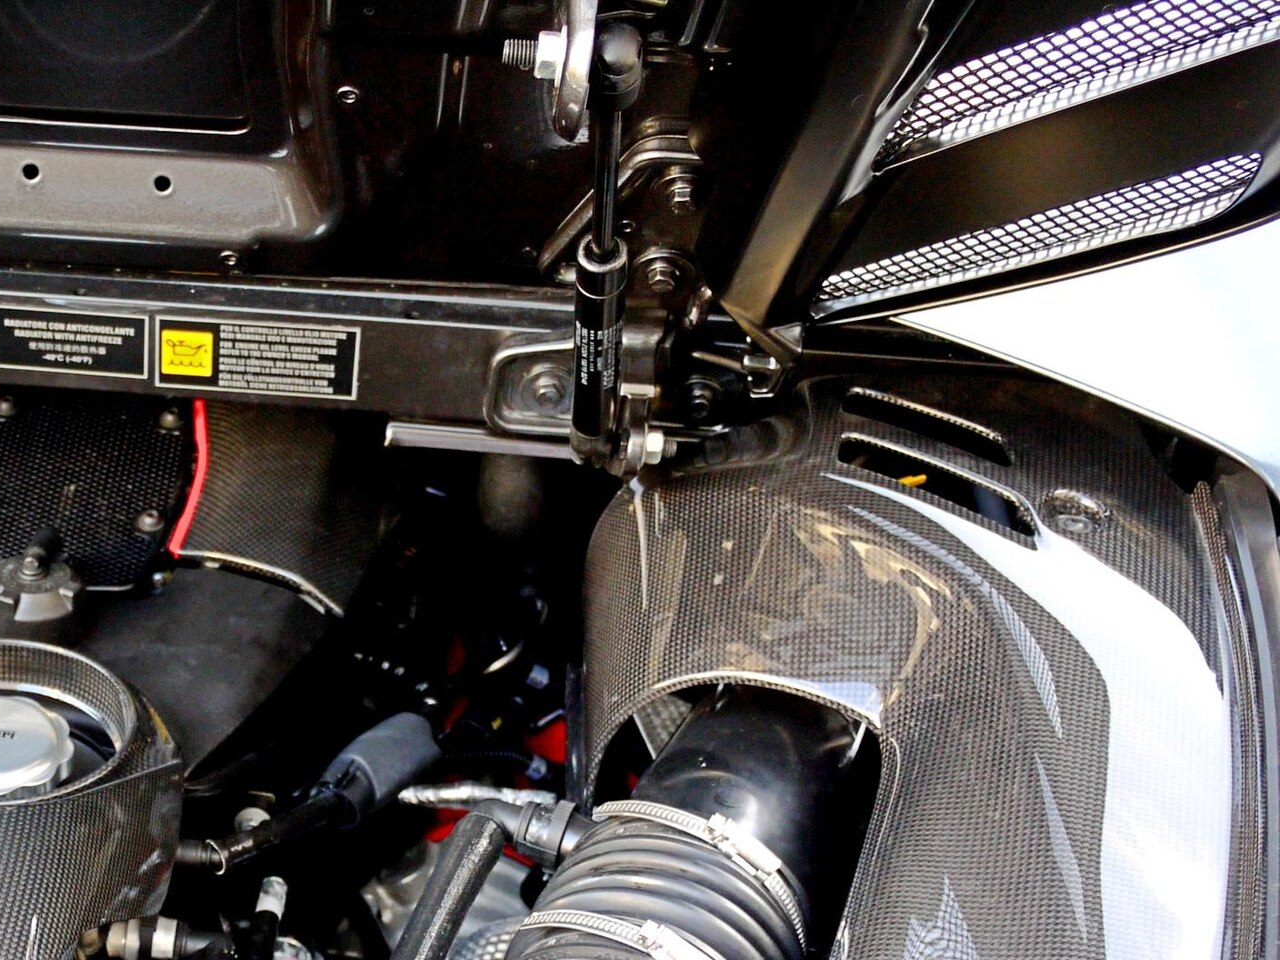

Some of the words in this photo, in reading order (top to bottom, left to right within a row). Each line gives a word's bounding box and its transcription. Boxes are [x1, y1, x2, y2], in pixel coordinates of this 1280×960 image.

[3, 318, 48, 330] RADIATORE
[48, 321, 65, 331] CON
[13, 328, 54, 340] RADIATOR
[54, 331, 75, 341] WITH
[75, 332, 122, 345] ANTIFREEZE
